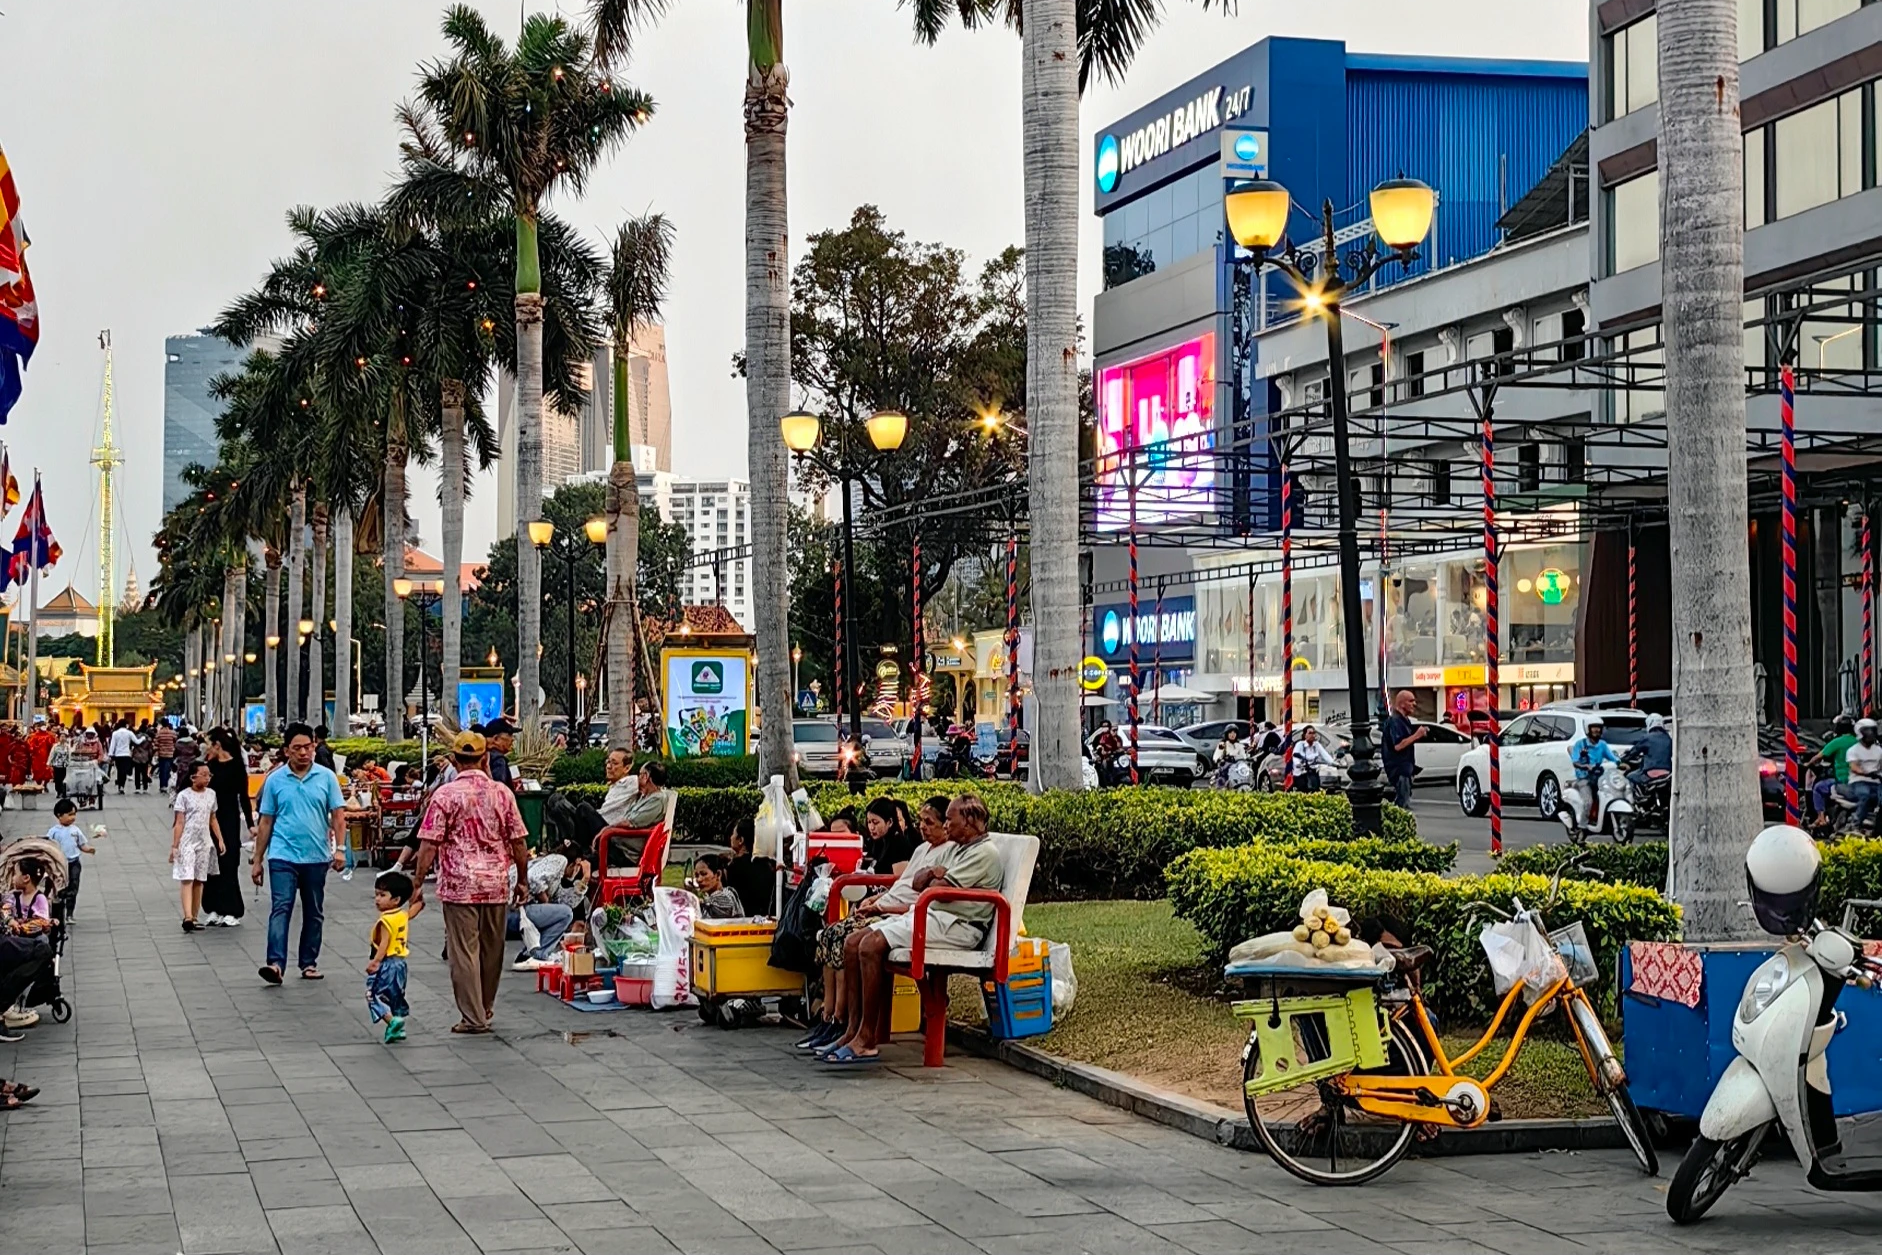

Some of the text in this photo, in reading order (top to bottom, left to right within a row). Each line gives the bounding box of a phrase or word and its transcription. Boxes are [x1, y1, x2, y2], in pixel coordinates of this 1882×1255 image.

[1121, 85, 1251, 174] WOORI BANK 24/7
[1160, 611, 1195, 642] BANK
